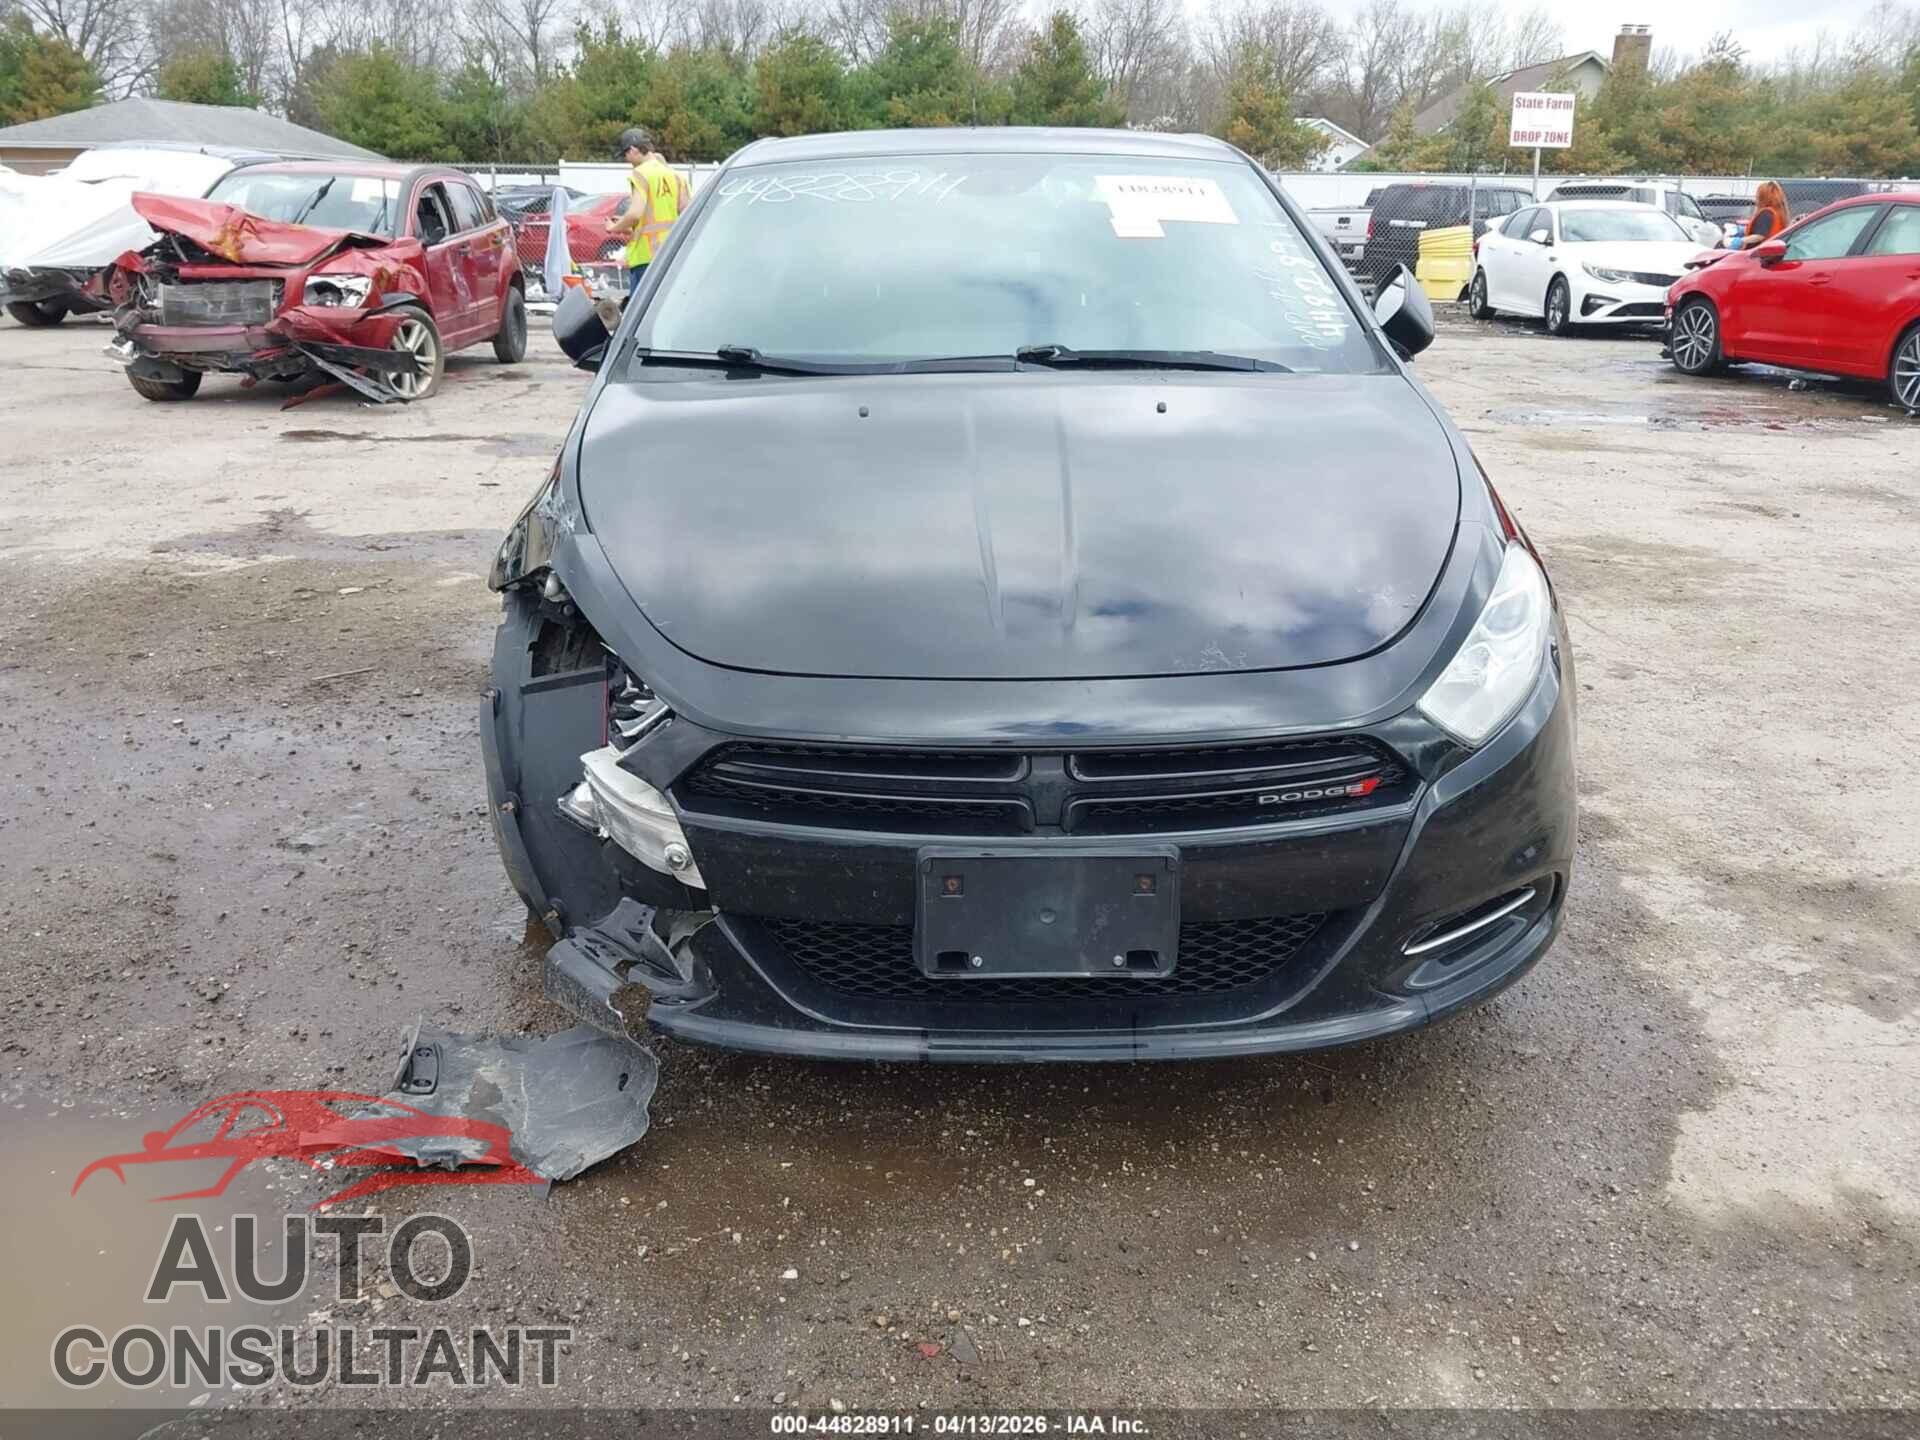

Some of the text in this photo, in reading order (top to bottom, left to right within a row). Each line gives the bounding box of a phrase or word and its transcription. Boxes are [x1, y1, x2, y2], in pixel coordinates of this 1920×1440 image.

[1515, 97, 1573, 110] State Farm
[1513, 131, 1569, 143] DROP ZONE
[1258, 783, 1364, 804] DODGE
